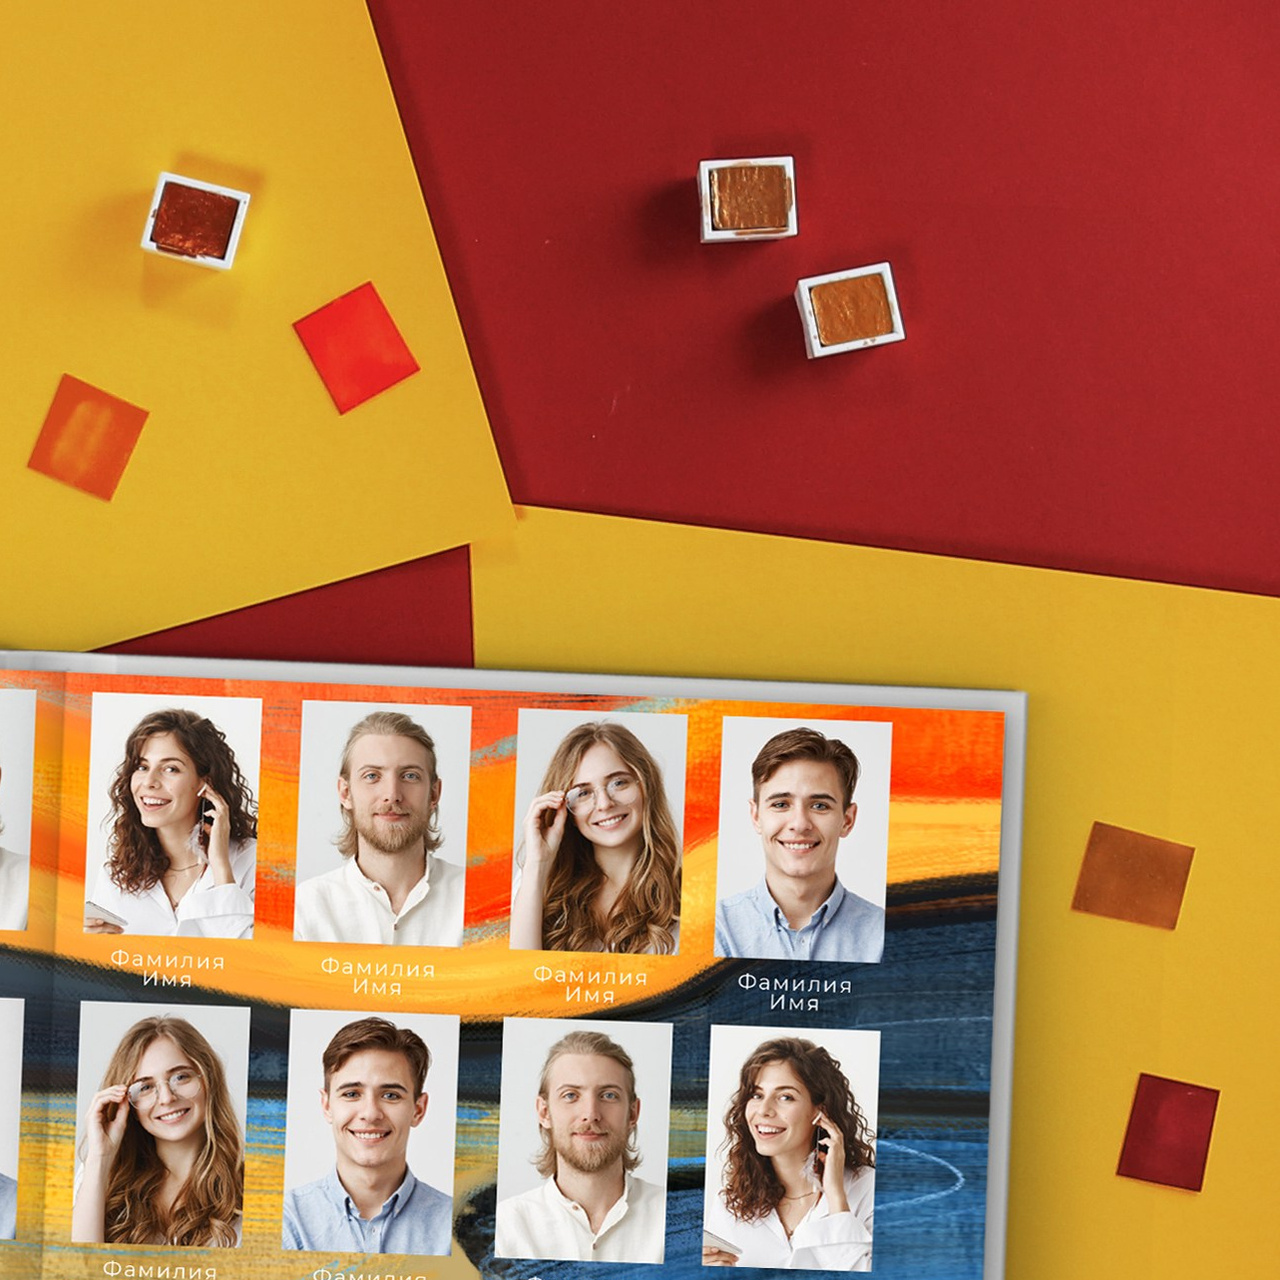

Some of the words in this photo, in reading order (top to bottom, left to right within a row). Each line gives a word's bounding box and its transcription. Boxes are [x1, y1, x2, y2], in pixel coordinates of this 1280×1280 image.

[110, 949, 225, 971] Фамилия
[320, 957, 435, 979] Фамилия
[142, 970, 193, 989] Имя
[533, 965, 648, 987] Фамилия
[737, 972, 852, 994] Фамилия
[352, 978, 403, 997] Имя
[565, 986, 616, 1005] Имя
[769, 993, 820, 1012] Имя
